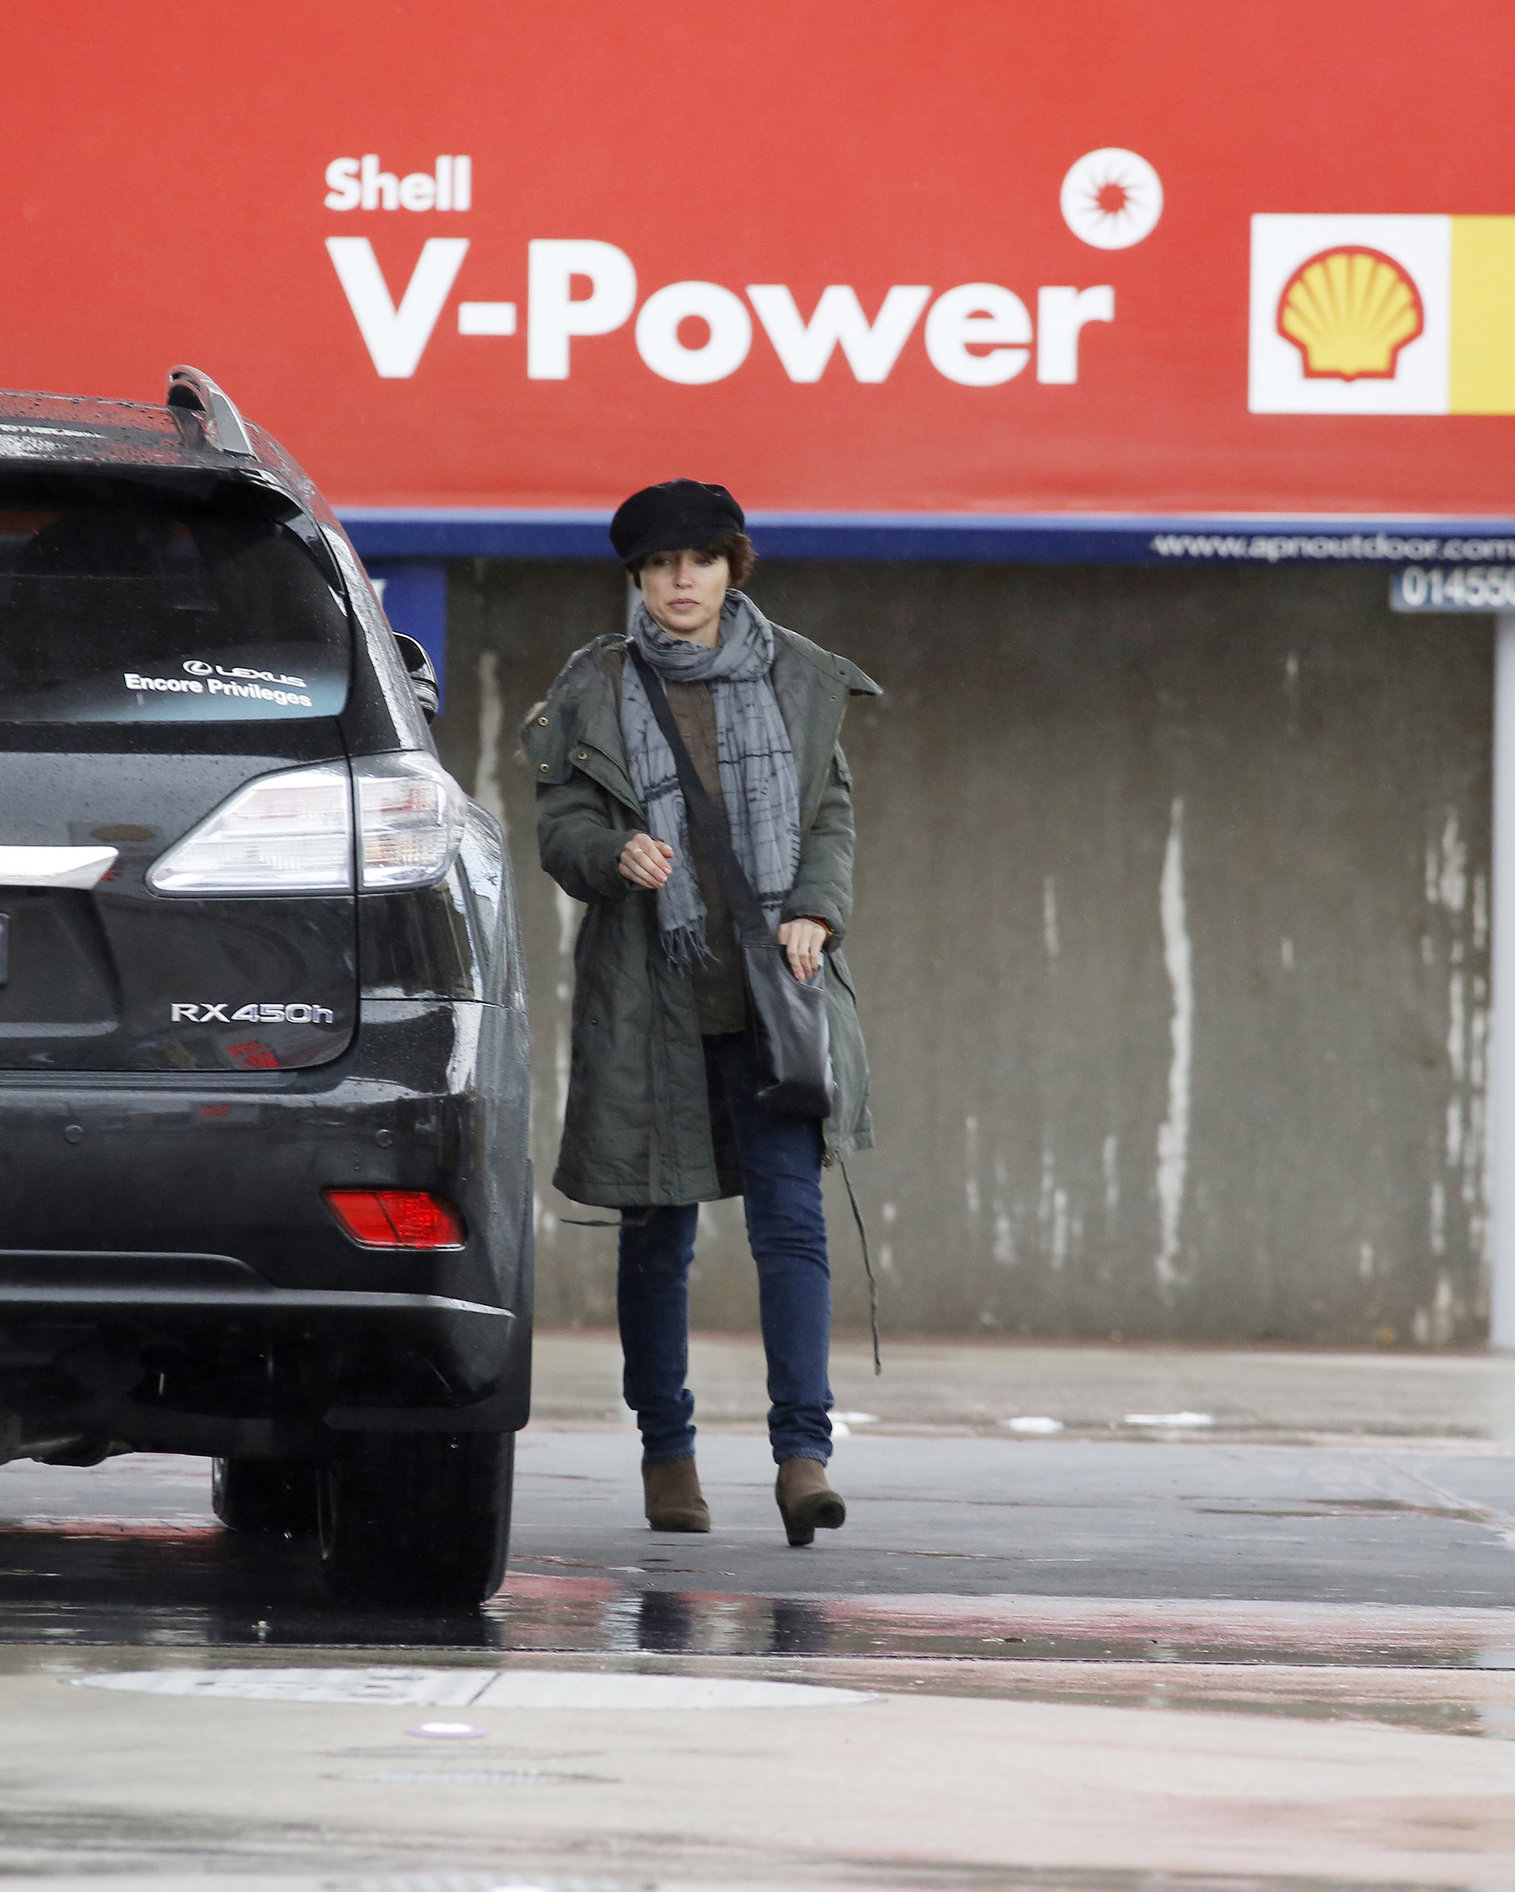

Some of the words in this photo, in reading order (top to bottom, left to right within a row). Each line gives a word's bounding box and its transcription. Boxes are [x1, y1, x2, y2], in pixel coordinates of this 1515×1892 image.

[325, 154, 472, 211] Shell
[325, 236, 1115, 386] V-Power
[1153, 534, 1515, 562] www.apnoutdoor.com
[124, 673, 203, 693] Encore
[207, 678, 313, 707] Privileges
[216, 665, 307, 687] LEXUS
[170, 1003, 334, 1023] RX450h
